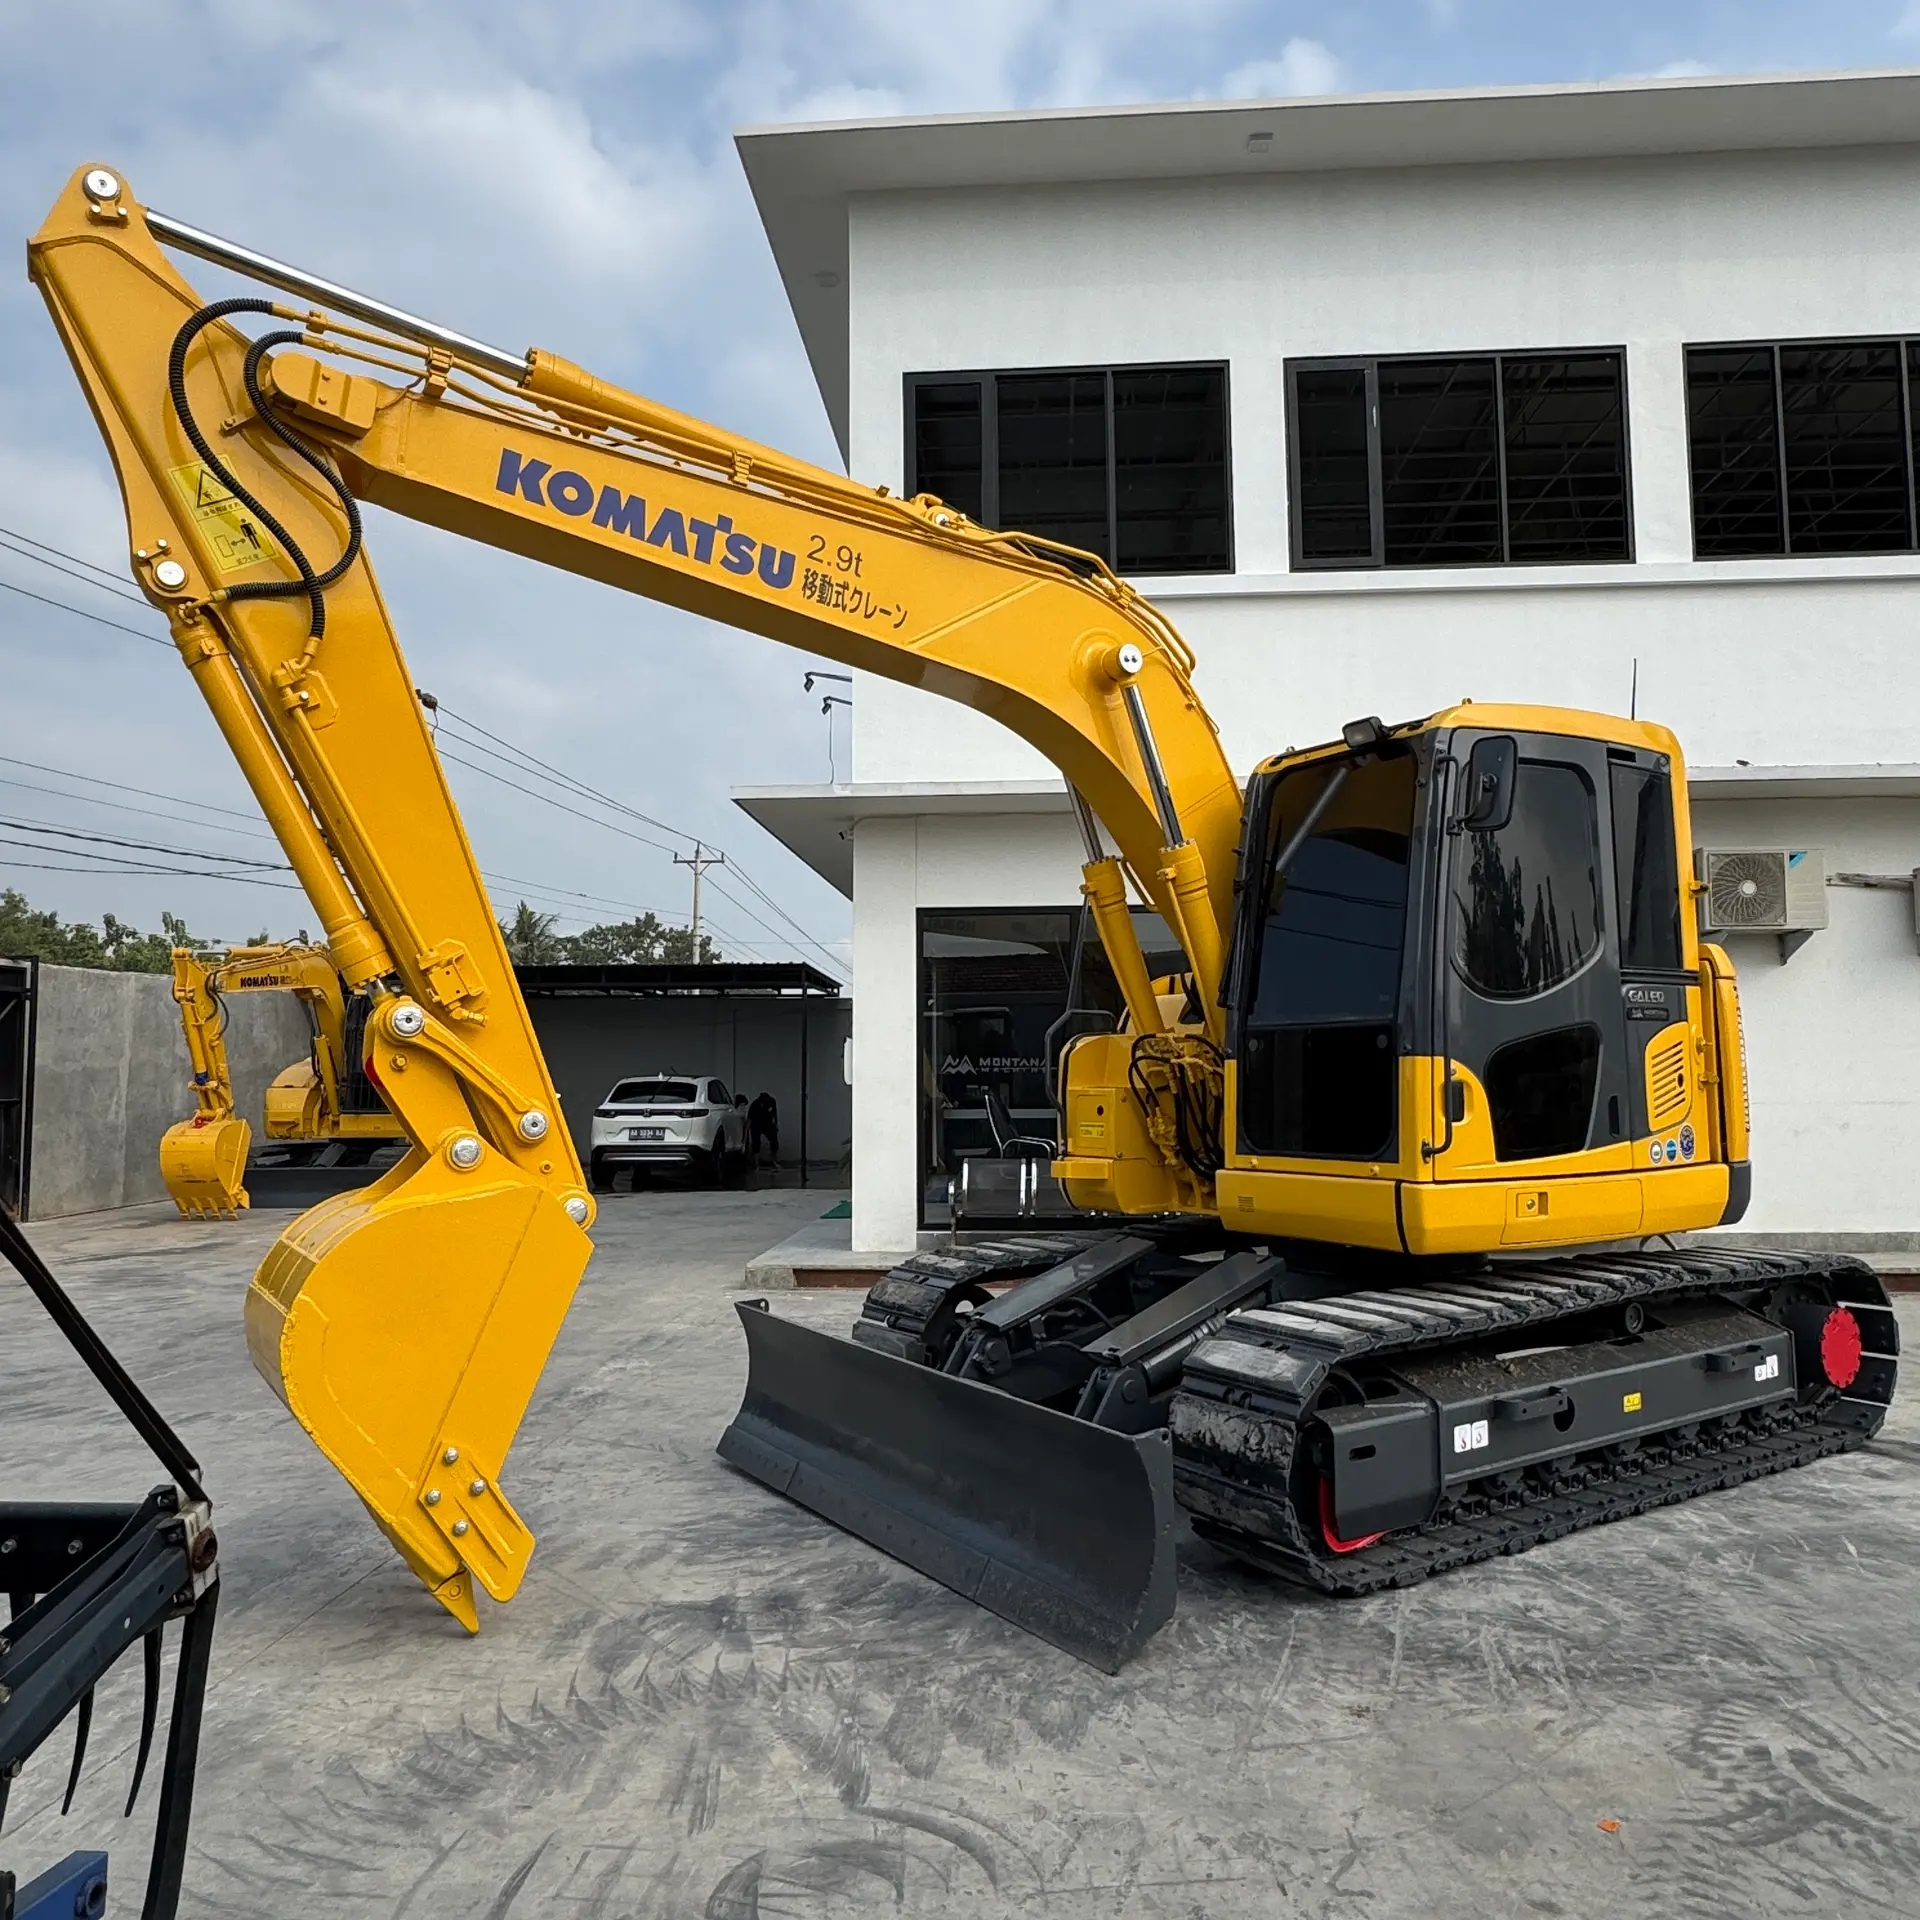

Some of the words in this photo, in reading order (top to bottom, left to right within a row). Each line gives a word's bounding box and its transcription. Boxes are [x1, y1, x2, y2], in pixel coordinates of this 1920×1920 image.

[495, 447, 796, 589] KOMATSU
[806, 534, 863, 578] 2.9t
[801, 567, 908, 629] 移動式クレーン
[240, 973, 279, 988] KOMATSU
